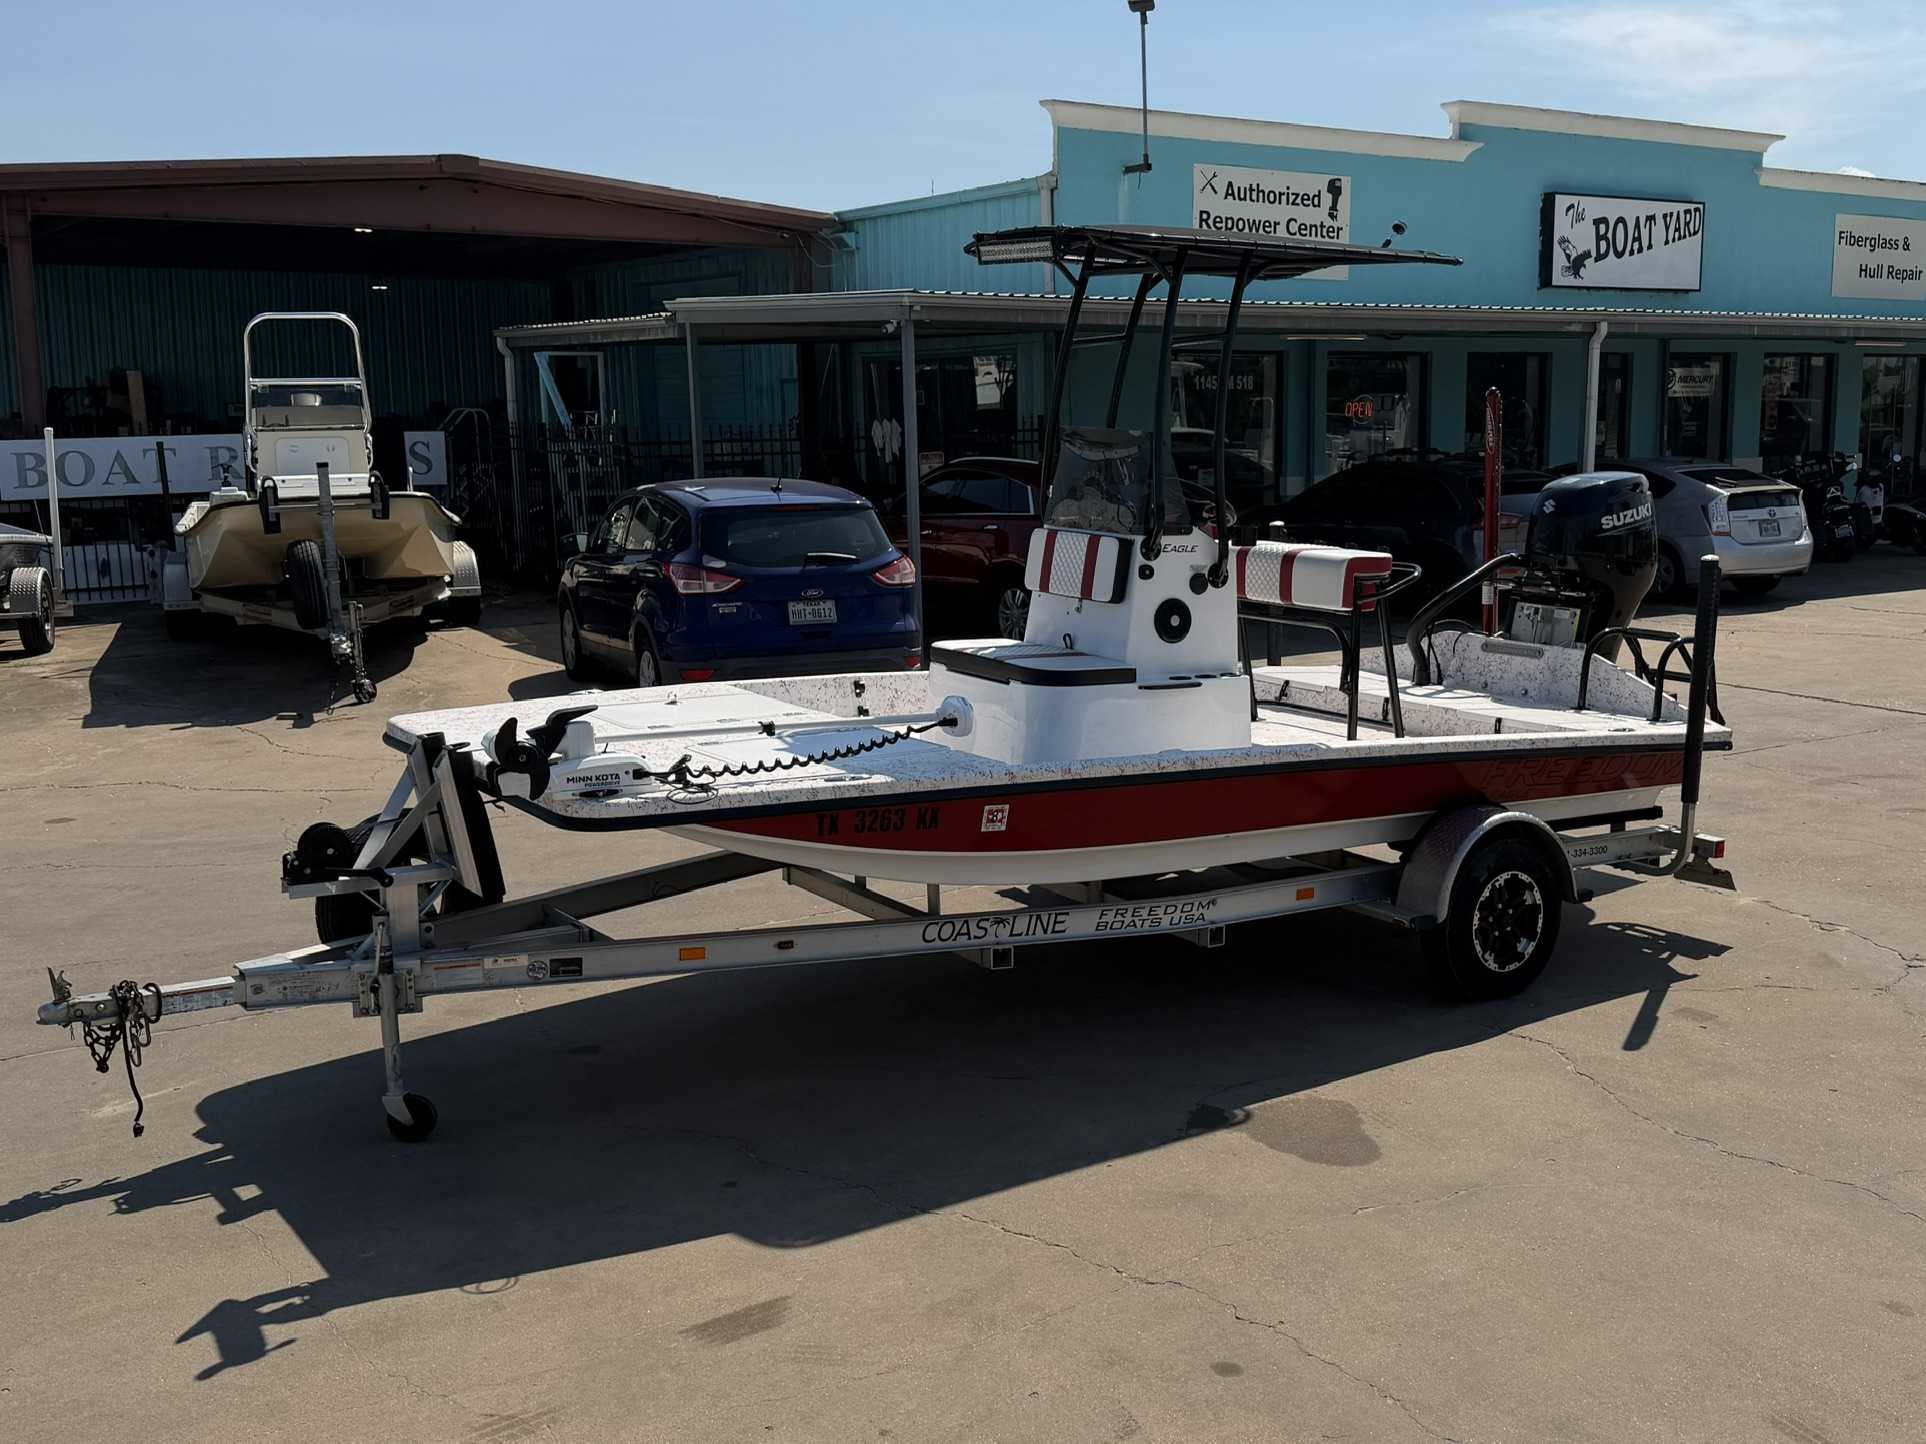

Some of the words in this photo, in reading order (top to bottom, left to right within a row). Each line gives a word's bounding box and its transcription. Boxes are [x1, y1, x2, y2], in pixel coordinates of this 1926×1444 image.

[1223, 180, 1321, 209] Authorized
[1199, 210, 1280, 235] Repower
[1286, 217, 1344, 240] Center
[1565, 200, 1586, 229] The
[1592, 214, 1657, 263] BOAT
[1662, 206, 1702, 246] YARD
[1838, 230, 1900, 252] Fiberglass
[1902, 236, 1911, 252] &
[1859, 263, 1884, 279] Hull
[1886, 264, 1924, 284] Repair
[1194, 375, 1217, 390] 1145
[1236, 375, 1254, 390] 518
[1345, 400, 1374, 417] OPEN
[10, 448, 177, 490] BOAT
[1600, 503, 1652, 530] SUZUKI
[1162, 543, 1199, 553] EAGLE
[566, 775, 593, 784] MINN
[595, 773, 621, 782] KOTA
[816, 812, 840, 836] TX
[854, 807, 905, 833] 3263
[1095, 915, 1162, 932] BOATS
[1169, 913, 1206, 927] USA
